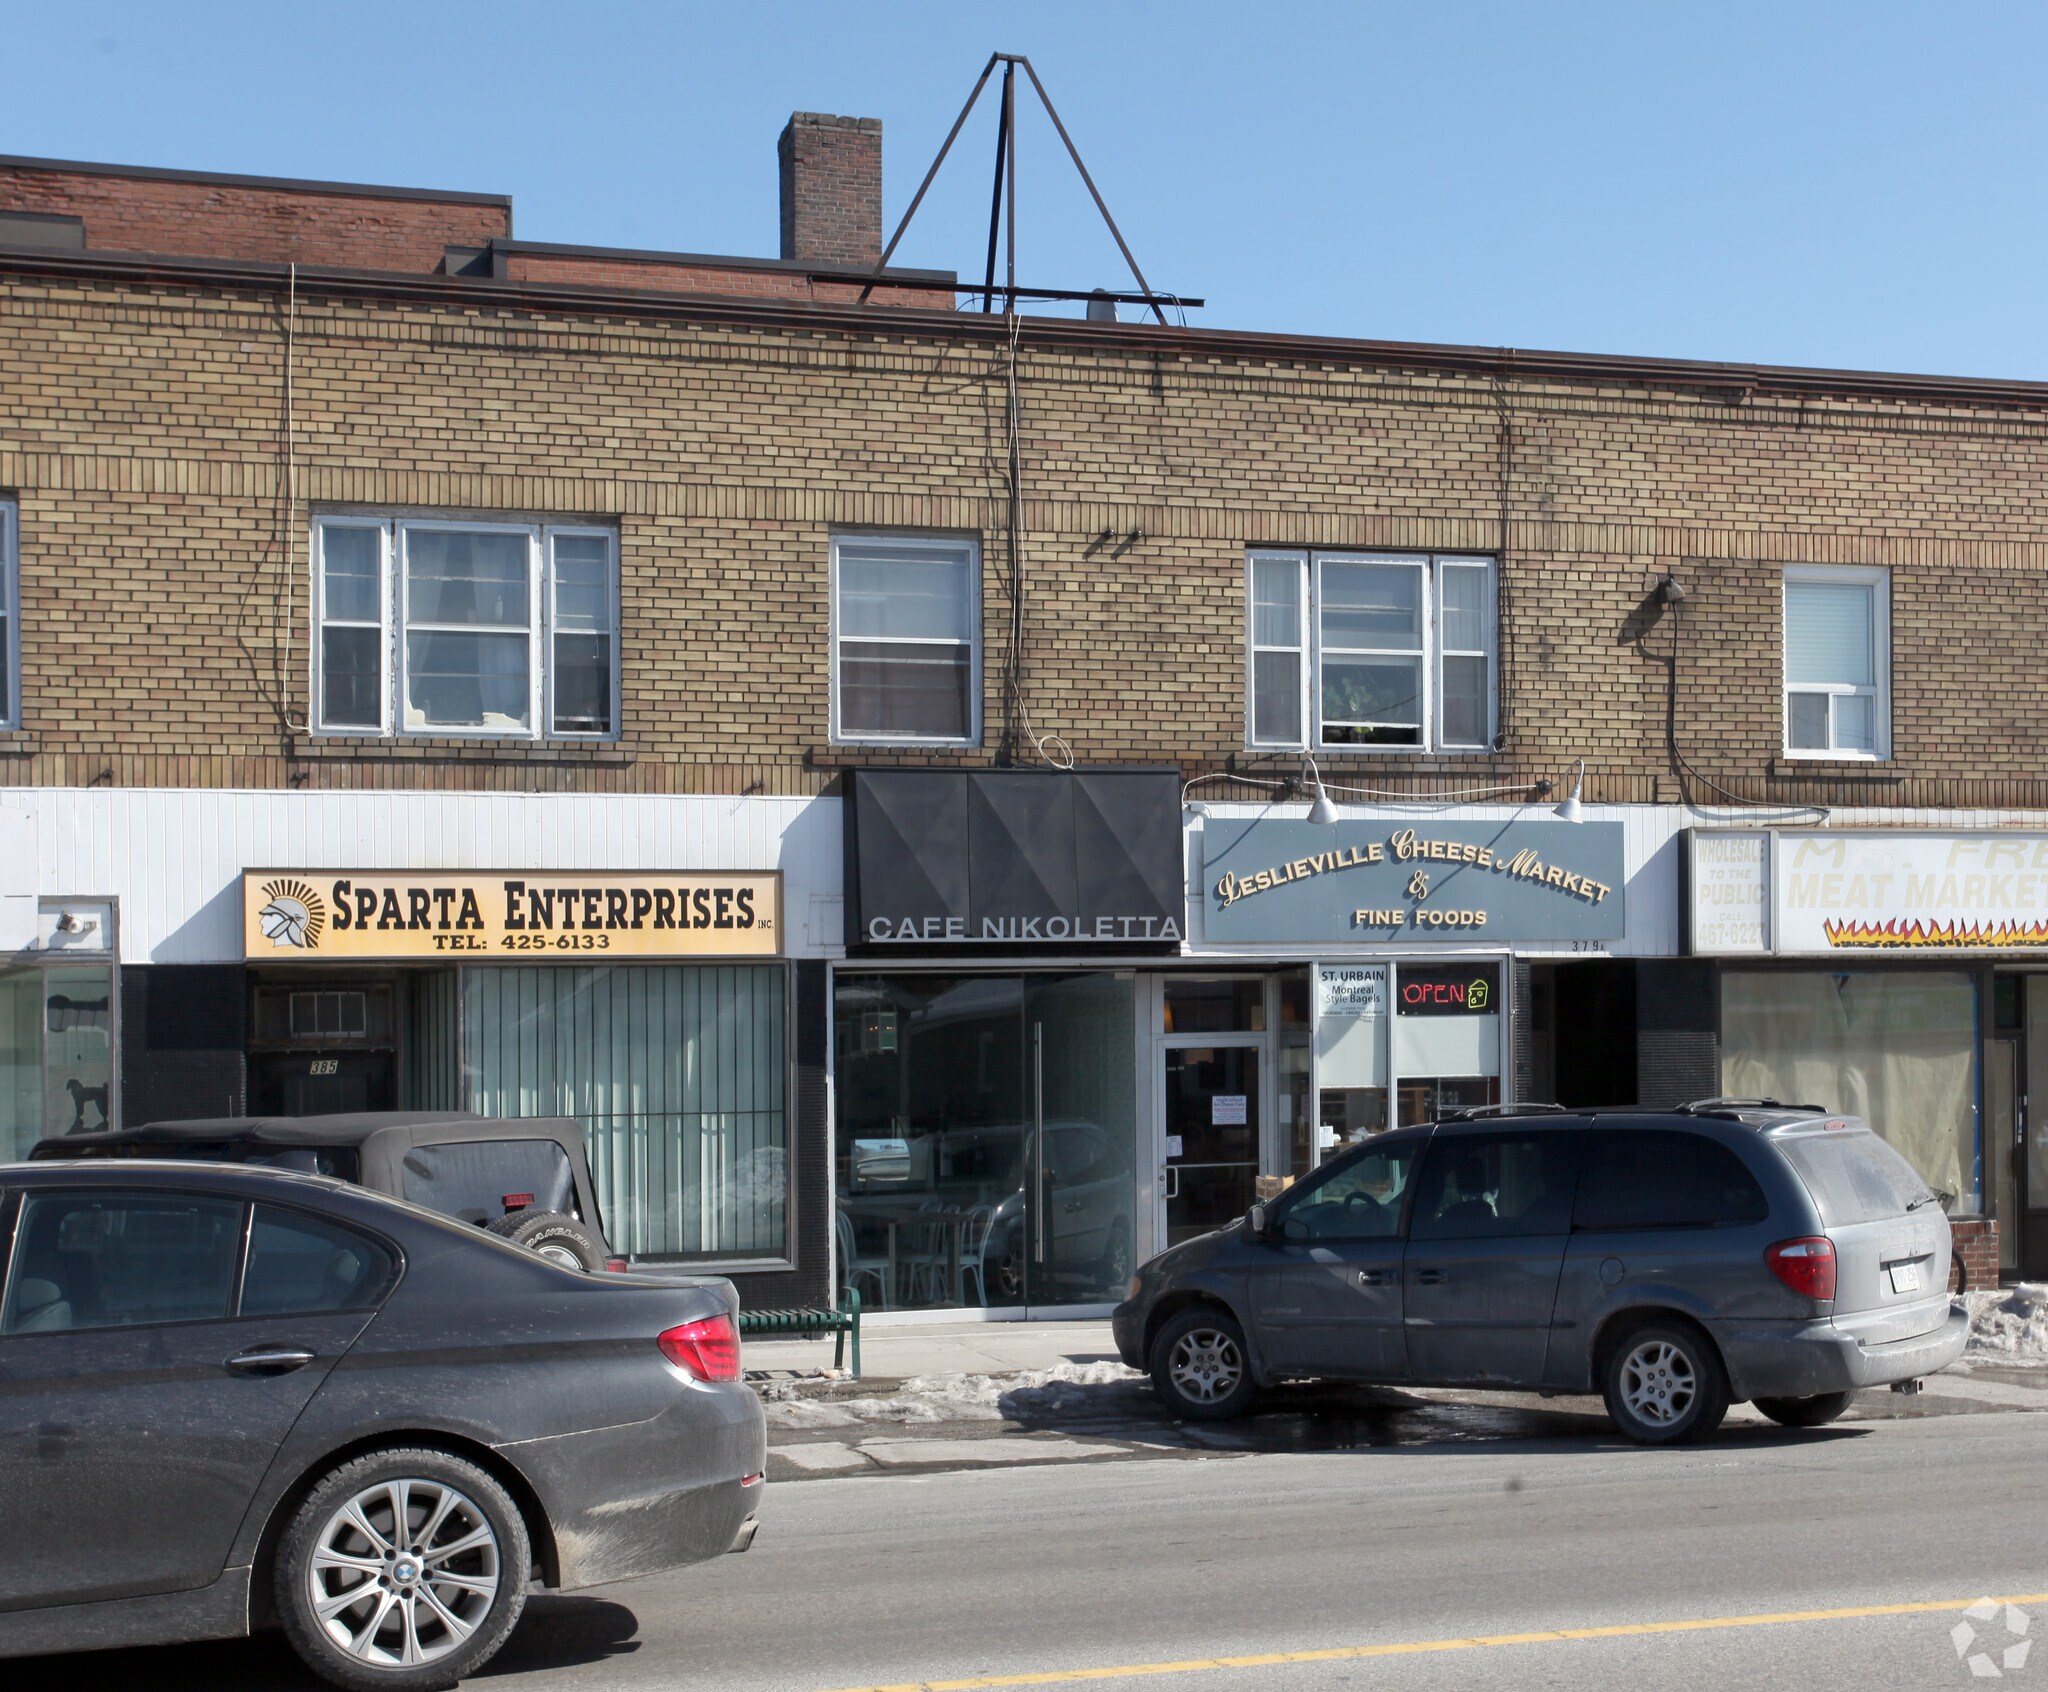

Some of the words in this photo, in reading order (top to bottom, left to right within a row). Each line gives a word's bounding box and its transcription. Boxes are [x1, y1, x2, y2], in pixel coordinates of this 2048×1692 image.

[1698, 839, 1765, 864] WHOLESALE
[1218, 841, 1384, 907] LESLIEVILLE
[1391, 828, 1494, 867] CHEESE
[1496, 848, 1611, 902] MARKET
[1709, 869, 1725, 880] TO
[1728, 868, 1752, 880] THE
[1408, 869, 1430, 899] &
[1699, 883, 1766, 906] PUBLIC
[1786, 873, 1894, 909] MEAT
[331, 879, 484, 931] SPARTA
[504, 880, 756, 930] ENTERPRISES
[757, 919, 775, 930] INC.
[868, 916, 964, 940] CAFE
[982, 916, 1181, 941] NIKOLETTA
[1355, 909, 1405, 926] FINE
[1415, 909, 1488, 927] FOODS
[432, 934, 488, 950] TEL:
[500, 934, 611, 950] 425-6133
[1321, 971, 1338, 982] ST.
[1340, 970, 1384, 982] URBAIN
[1325, 994, 1348, 1005] Style
[1349, 993, 1381, 1005] Bagels
[1331, 984, 1374, 994] Montreal
[1403, 983, 1464, 1003] OPEN
[311, 1060, 336, 1074] 385
[525, 1227, 590, 1249] RANGLER
